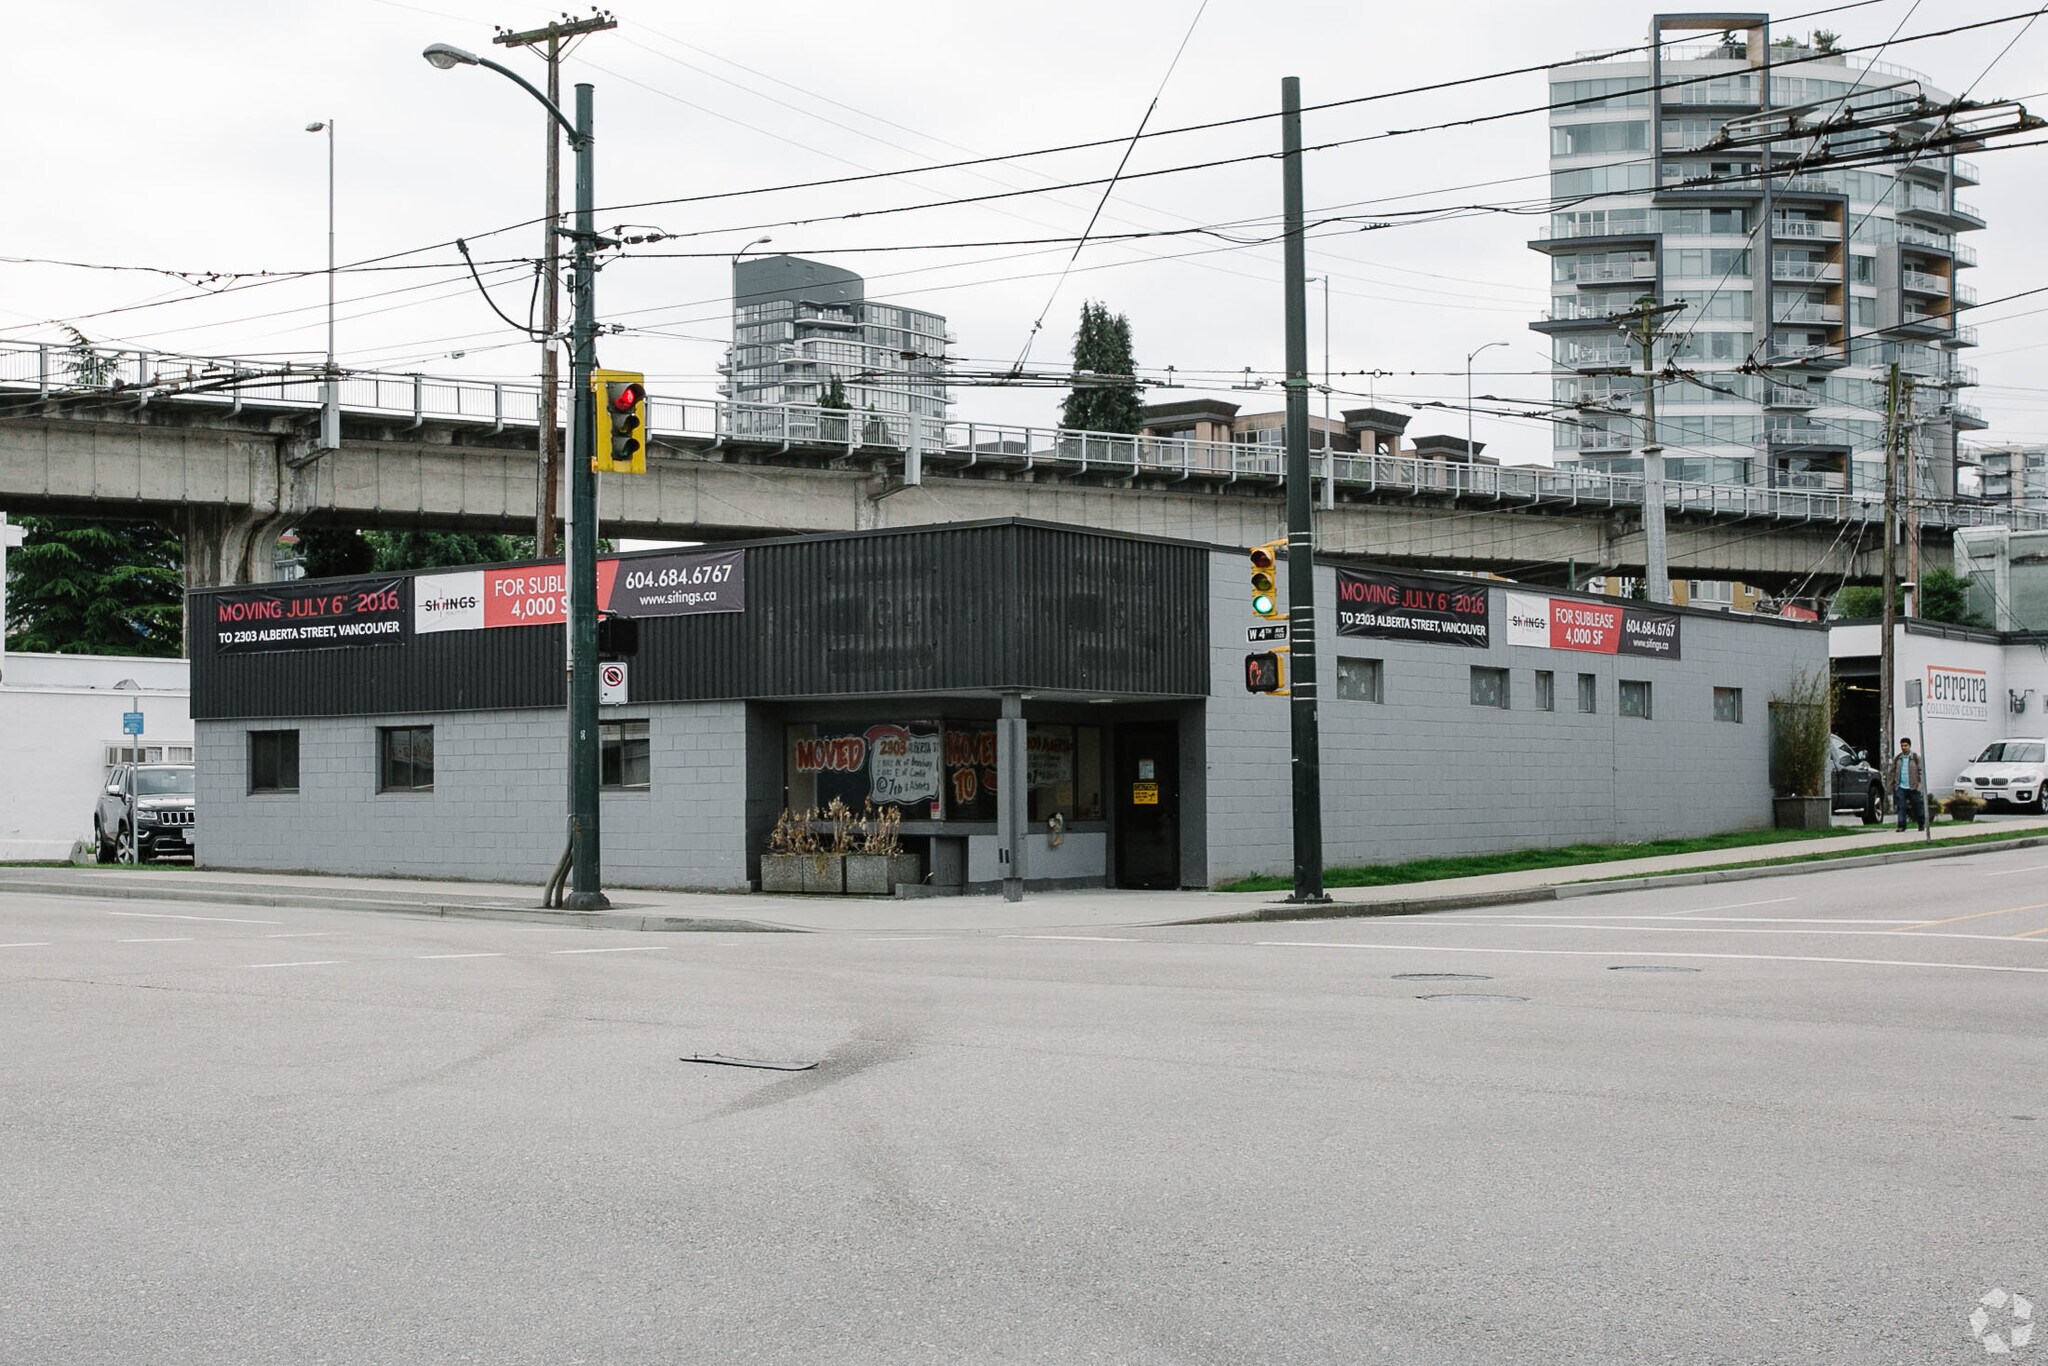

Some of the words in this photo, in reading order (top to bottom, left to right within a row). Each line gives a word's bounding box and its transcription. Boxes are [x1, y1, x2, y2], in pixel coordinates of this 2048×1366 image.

[495, 578, 525, 597] FOR
[625, 564, 733, 589] 604.684.6767
[219, 600, 282, 622] MOVING
[286, 596, 328, 618] JULY
[356, 591, 399, 612] 2016
[511, 597, 556, 619] 4,000
[560, 596, 567, 613] S
[639, 590, 717, 606] www.sitings.ca
[1340, 581, 1397, 605] MOVING
[1401, 589, 1434, 609] JULY
[1455, 594, 1485, 614] 2016
[1340, 611, 1354, 624] TO
[1355, 613, 1376, 626] 2303
[1376, 615, 1410, 629] ALBERTA
[1411, 620, 1441, 634] STREET,
[1441, 622, 1486, 636] VANCOUVER
[1555, 608, 1574, 624] FOR
[1575, 610, 1614, 629] SUBLEASE
[1626, 619, 1676, 637] 604.684.6767
[219, 633, 233, 643] TO
[234, 630, 257, 642] 2303
[258, 628, 299, 641] ALBERTA
[300, 626, 337, 639] STREET,
[338, 621, 400, 636] VANCOUVER
[1249, 629, 1257, 640] W
[1258, 628, 1272, 639] 4TH
[1565, 628, 1591, 646] 4,000
[1592, 630, 1604, 645] SF
[1927, 665, 1987, 703] Ferreira
[1927, 702, 1960, 715] COLLISION
[1961, 705, 1988, 718] CENTRES
[796, 737, 865, 772] MOVED
